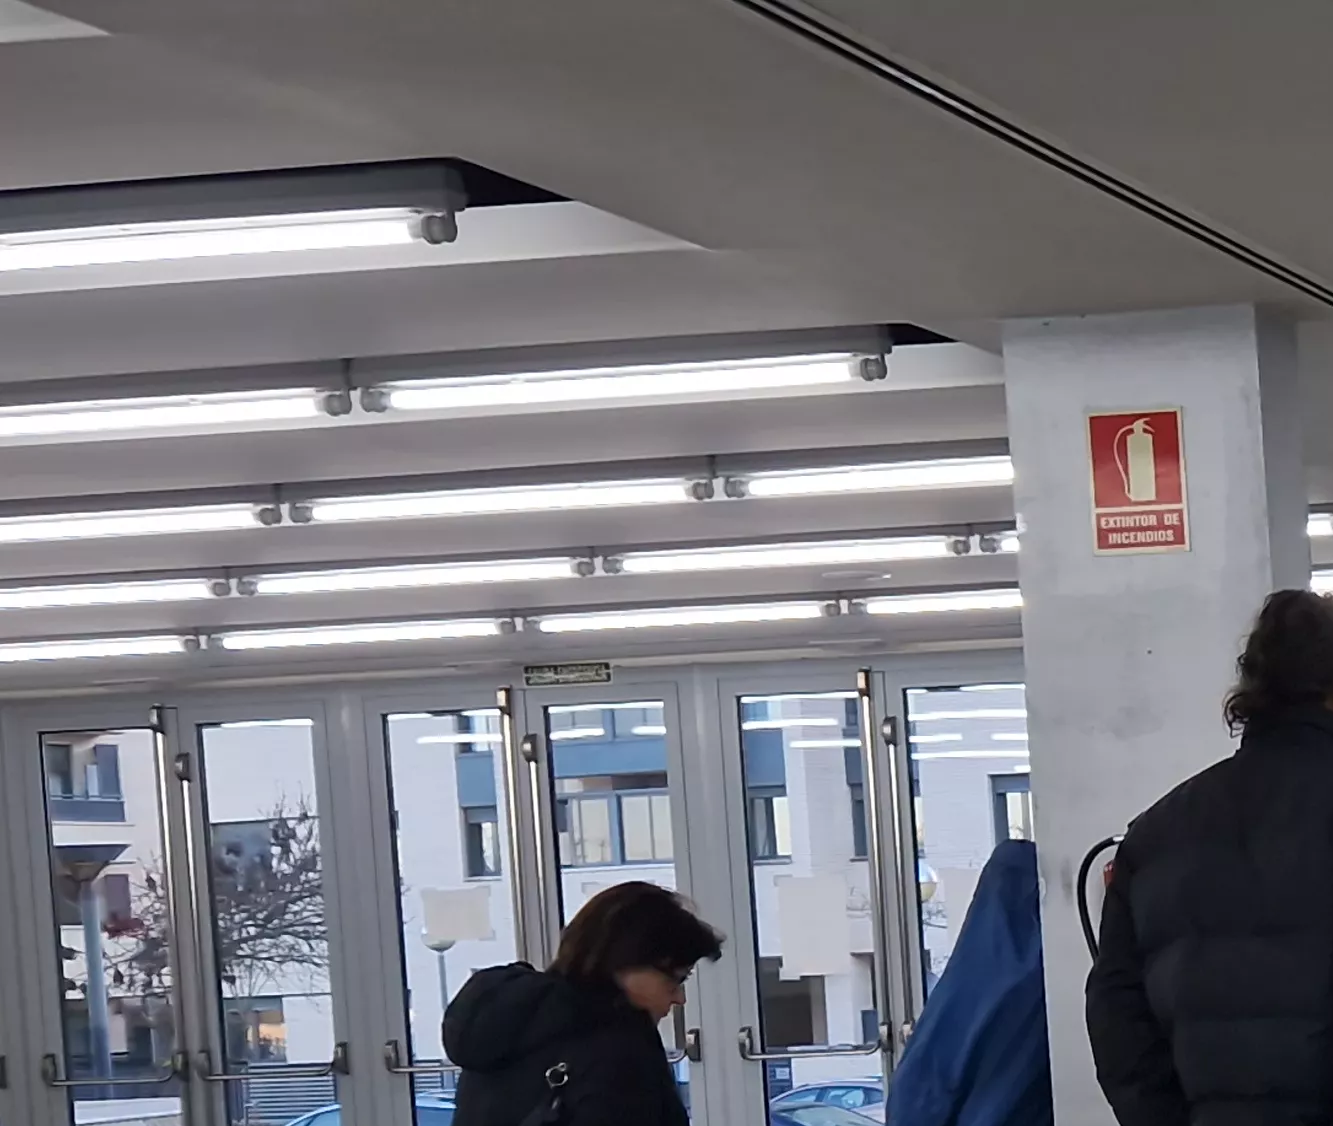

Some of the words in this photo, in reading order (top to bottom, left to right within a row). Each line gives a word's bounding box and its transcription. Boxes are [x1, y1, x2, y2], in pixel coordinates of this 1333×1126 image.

[1101, 514, 1157, 529] EXTINTOR
[1164, 512, 1180, 525] DE
[1108, 530, 1174, 544] INCENDIOS
